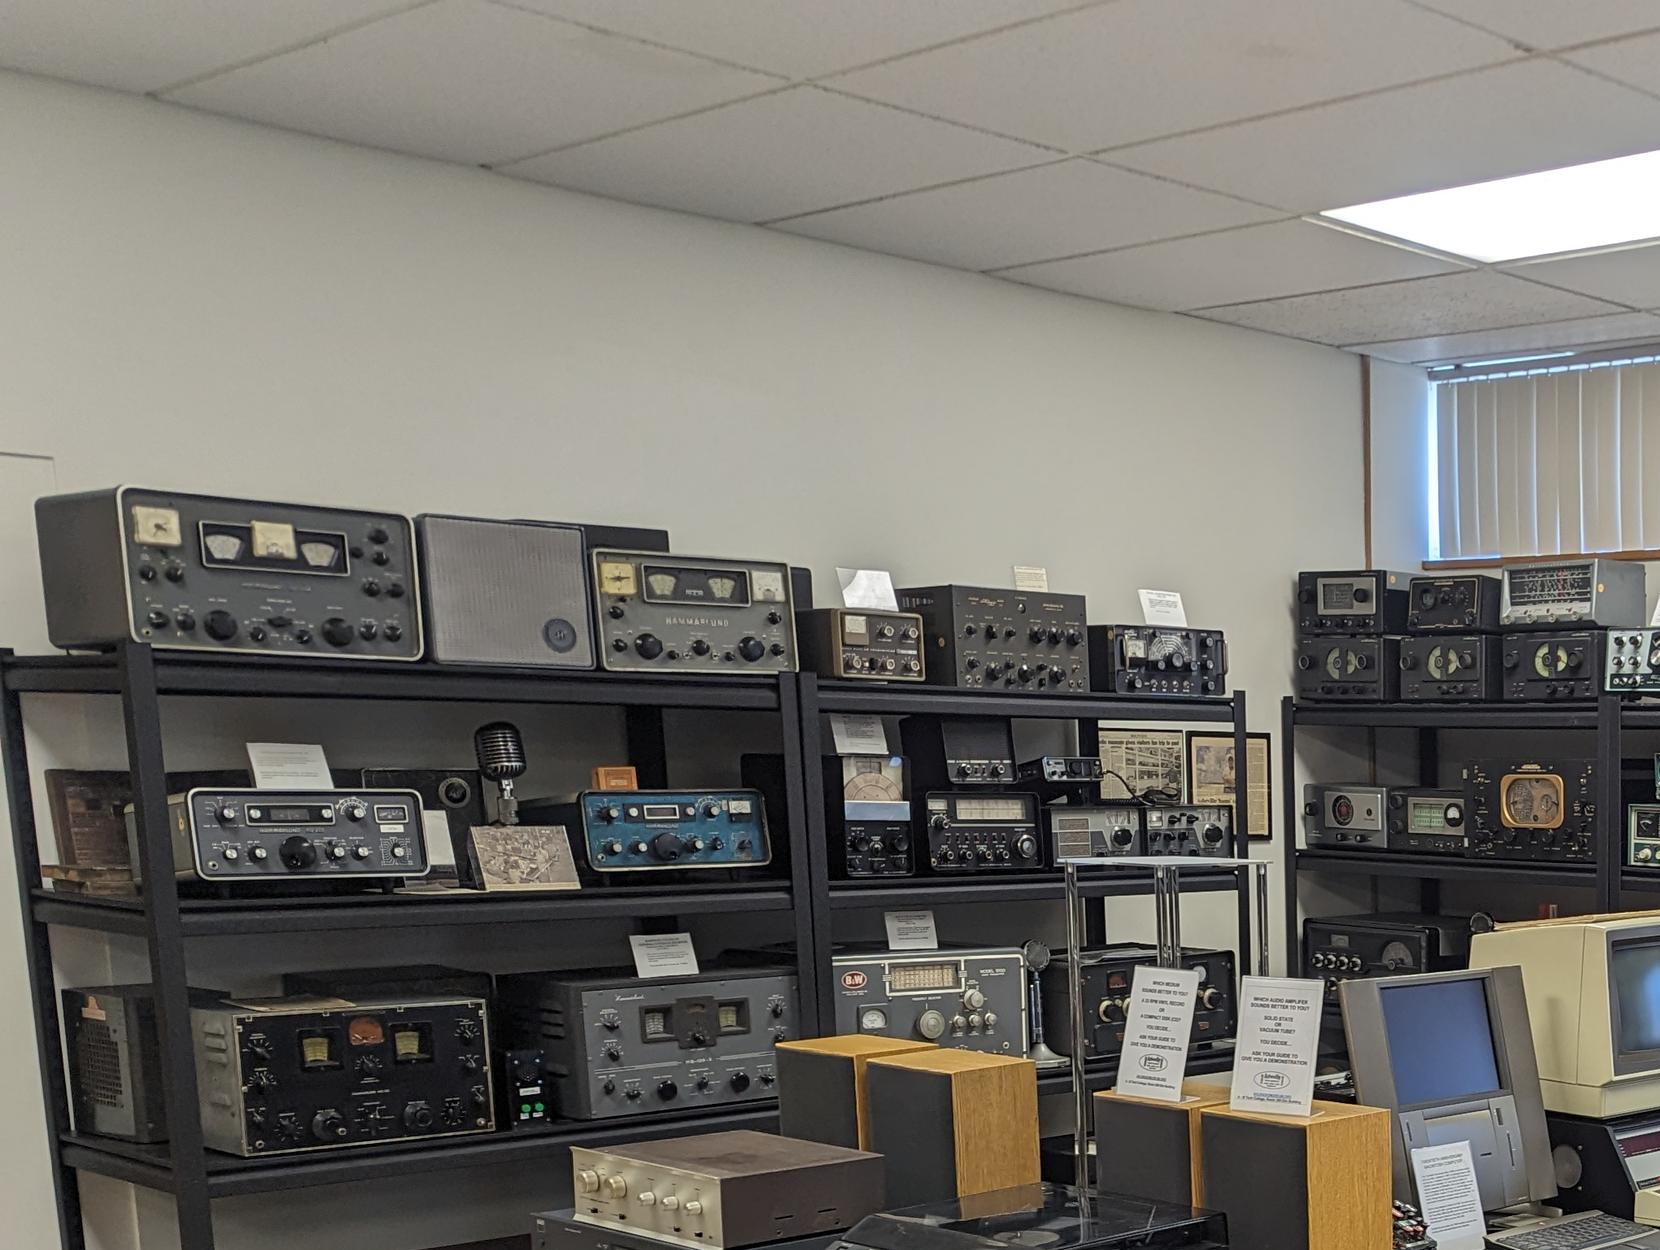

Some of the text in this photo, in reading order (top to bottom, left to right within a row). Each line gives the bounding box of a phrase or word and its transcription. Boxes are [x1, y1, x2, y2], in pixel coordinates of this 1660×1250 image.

[665, 616, 729, 628] HAMMARLUND
[844, 974, 864, 985] B&W
[1267, 1058, 1308, 1067] DEMONSTRATION
